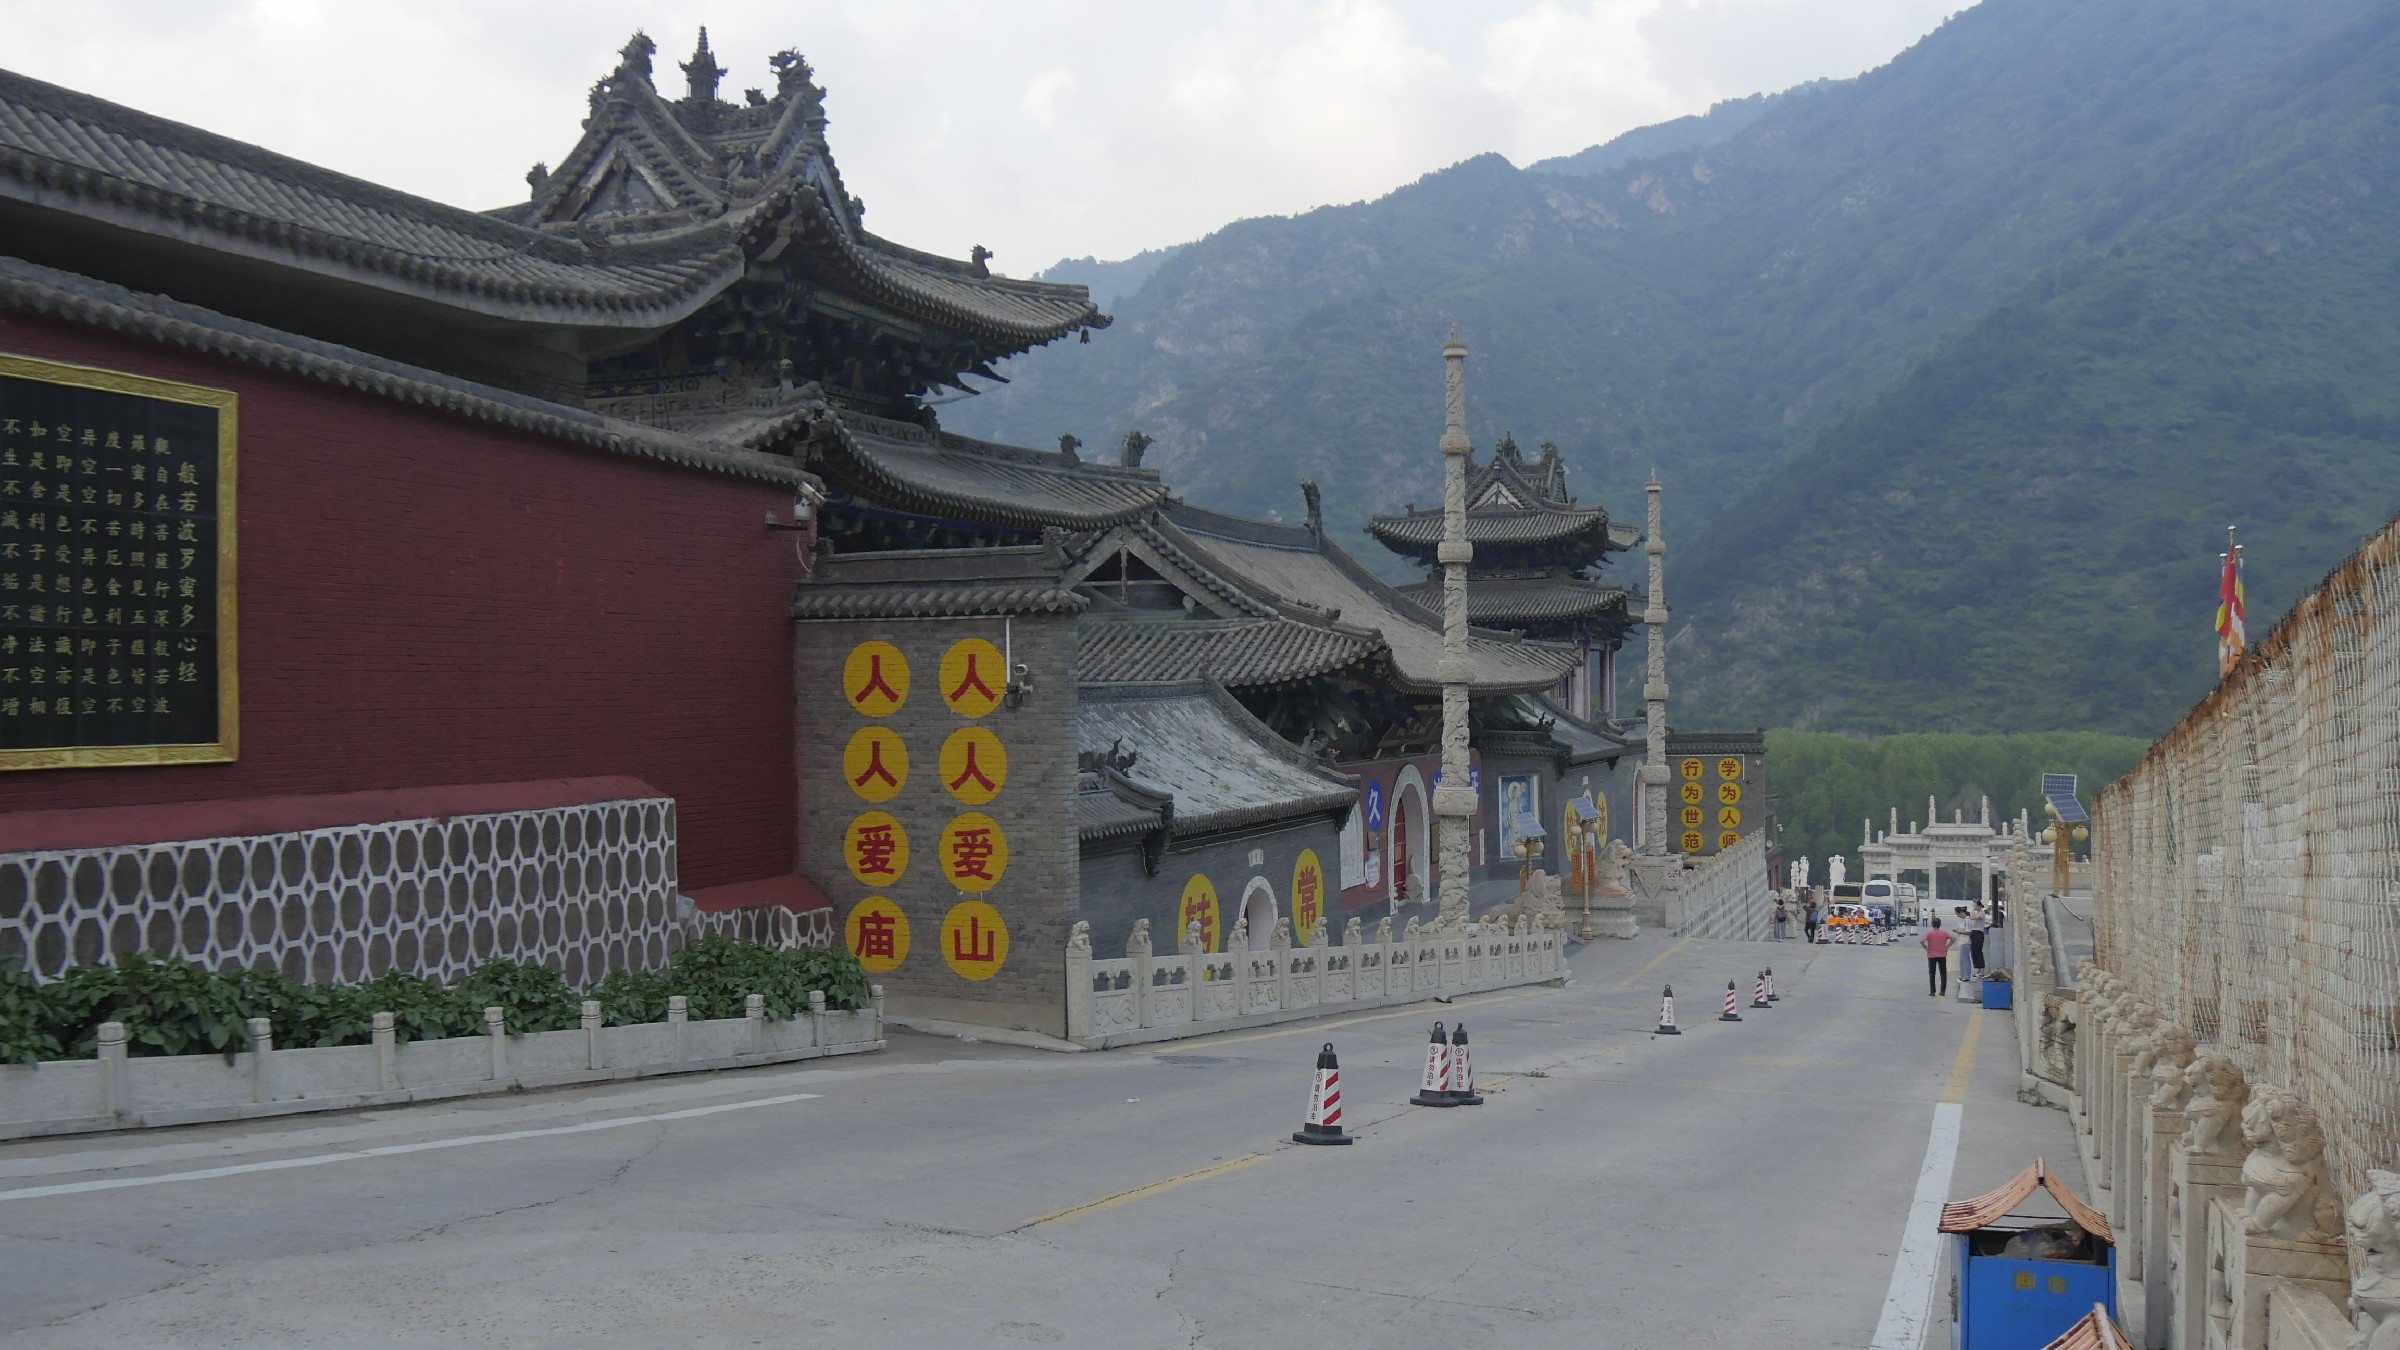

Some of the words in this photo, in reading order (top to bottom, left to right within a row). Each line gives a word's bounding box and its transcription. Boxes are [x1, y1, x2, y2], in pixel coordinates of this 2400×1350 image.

[177, 461, 199, 682] 般若波罗蜜多心经
[855, 654, 899, 958] 人人爱庙
[950, 653, 995, 962] 人人爱山
[1369, 788, 1380, 823] 久
[1684, 761, 1699, 848] 行为世范
[1721, 760, 1736, 848] 学为人师
[1297, 866, 1317, 929] 常
[1310, 1084, 1320, 1121] 请勿泊车
[1426, 1056, 1435, 1087] 请勿泊车
[1456, 1058, 1464, 1089] 请勿泊车
